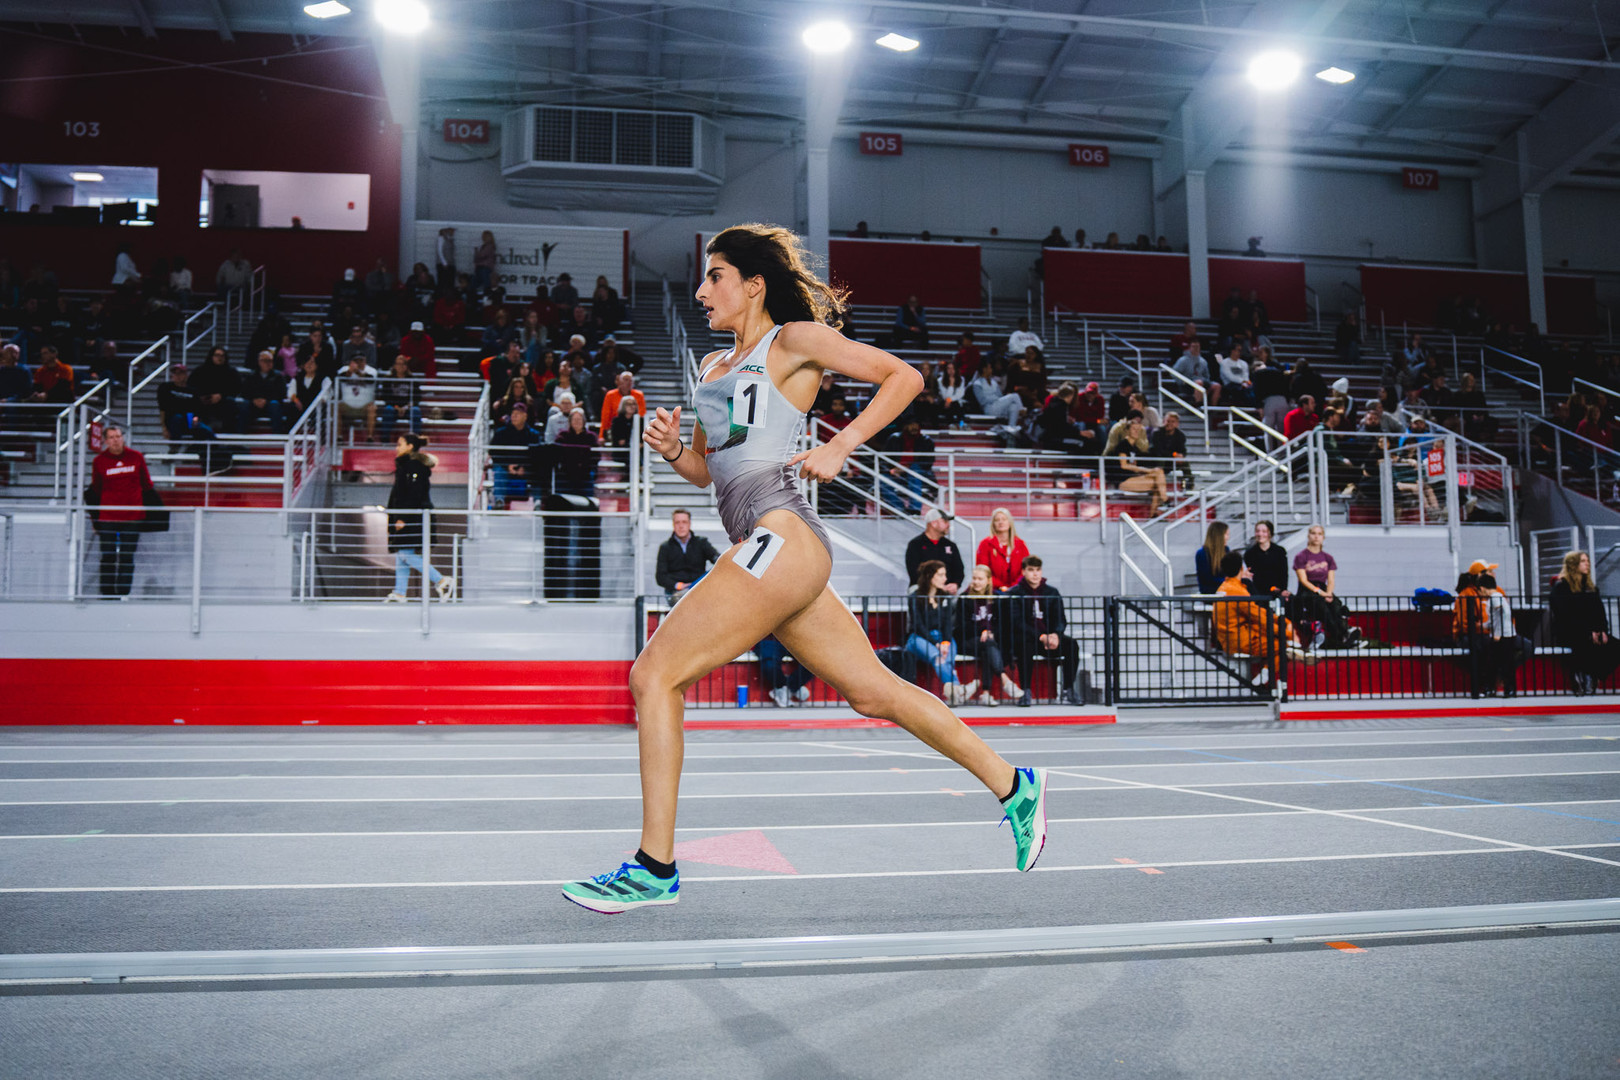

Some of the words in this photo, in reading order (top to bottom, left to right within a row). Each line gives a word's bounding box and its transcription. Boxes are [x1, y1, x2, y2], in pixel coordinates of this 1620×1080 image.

[63, 121, 100, 137] 103
[449, 123, 484, 138] 104
[865, 137, 897, 151] 105
[1073, 149, 1105, 163] 106
[1407, 172, 1433, 186] 107
[500, 274, 518, 285] OR
[522, 275, 559, 286] TRAC
[739, 364, 765, 374] ACC
[742, 383, 758, 425] 1
[746, 533, 774, 570] 1
